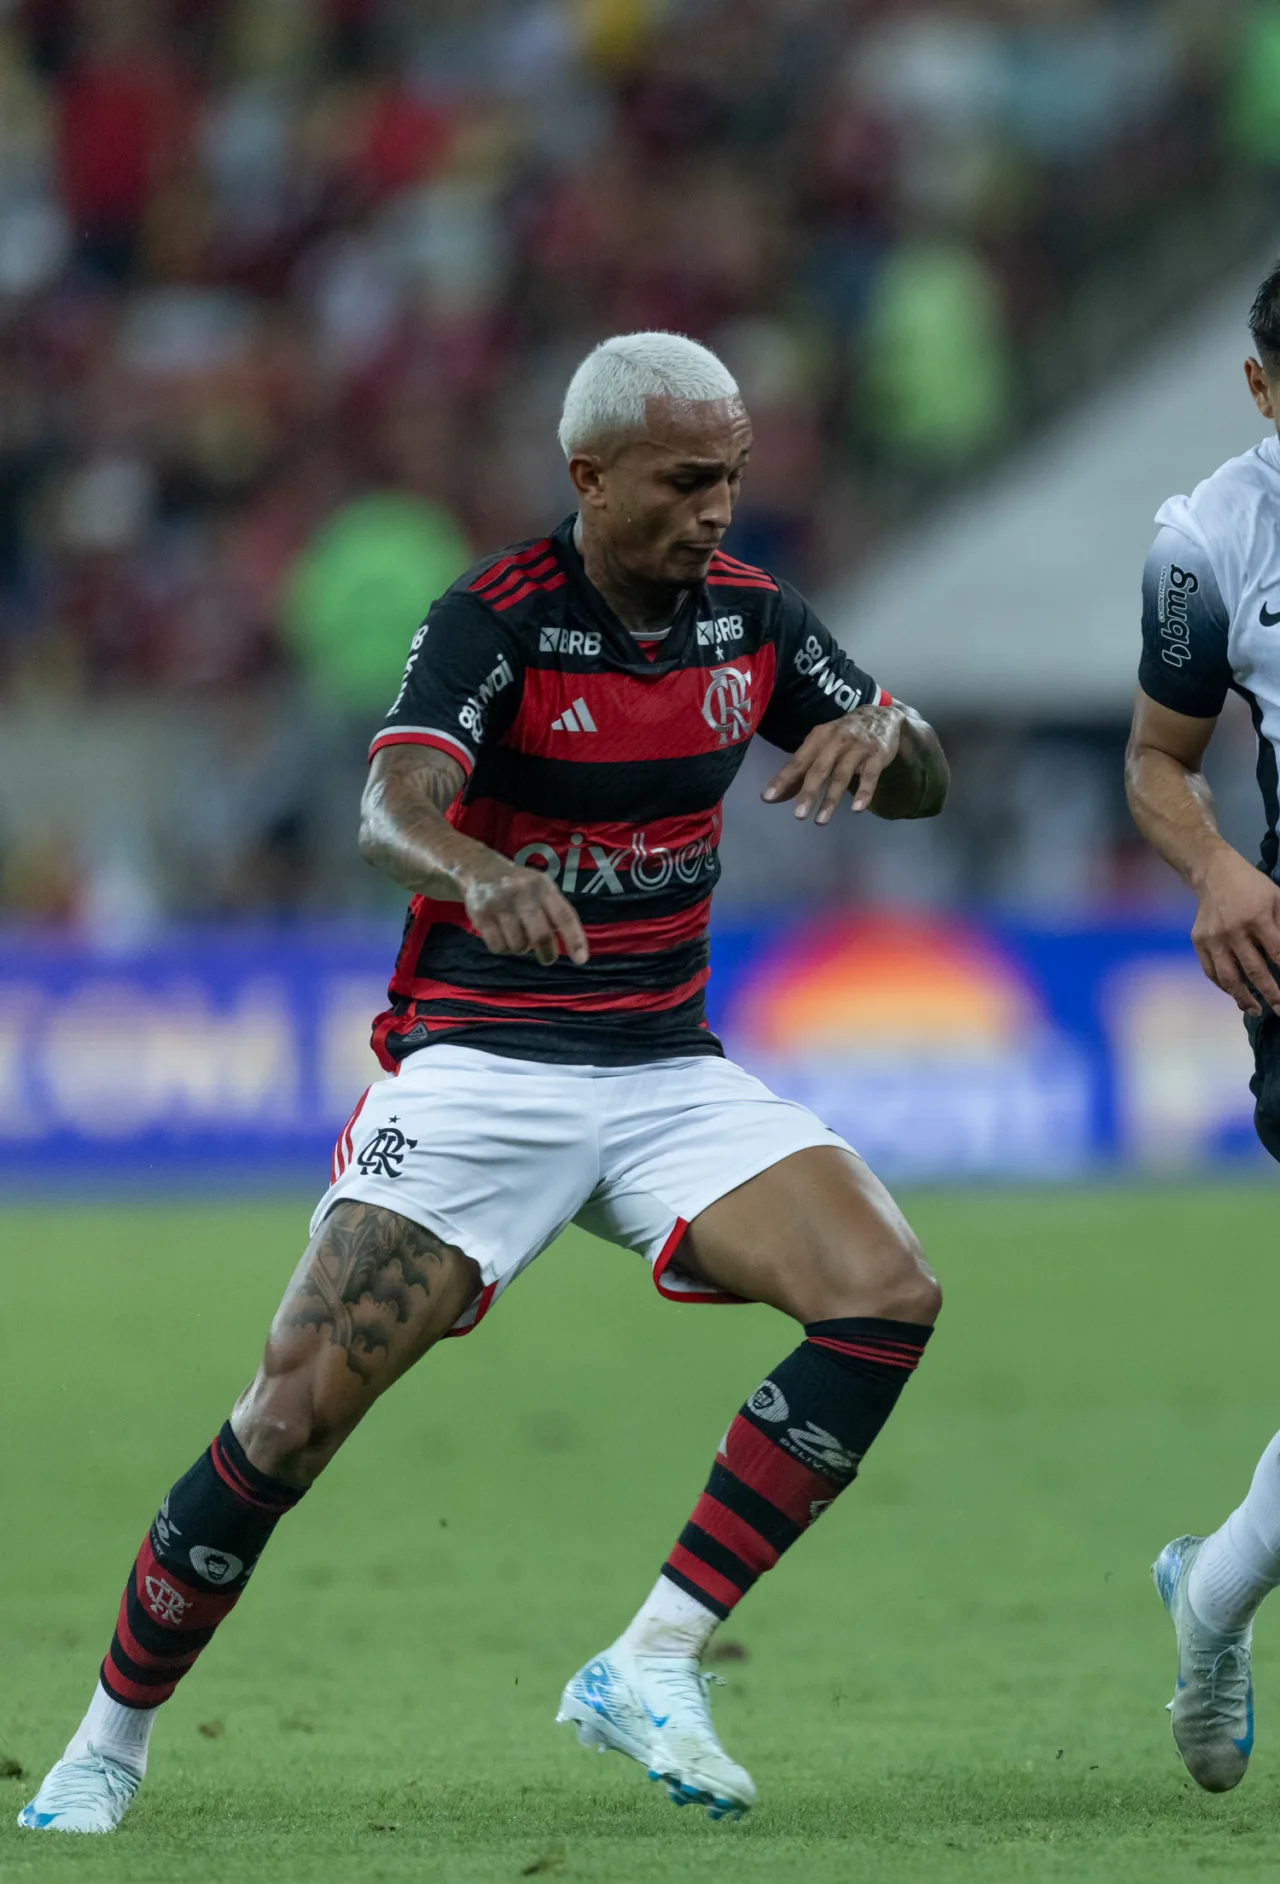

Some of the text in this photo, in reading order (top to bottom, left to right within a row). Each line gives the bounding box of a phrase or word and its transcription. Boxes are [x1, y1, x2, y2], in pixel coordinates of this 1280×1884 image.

[1160, 563, 1200, 645] bmg
[558, 630, 602, 656] BRB
[713, 614, 745, 643] BRB
